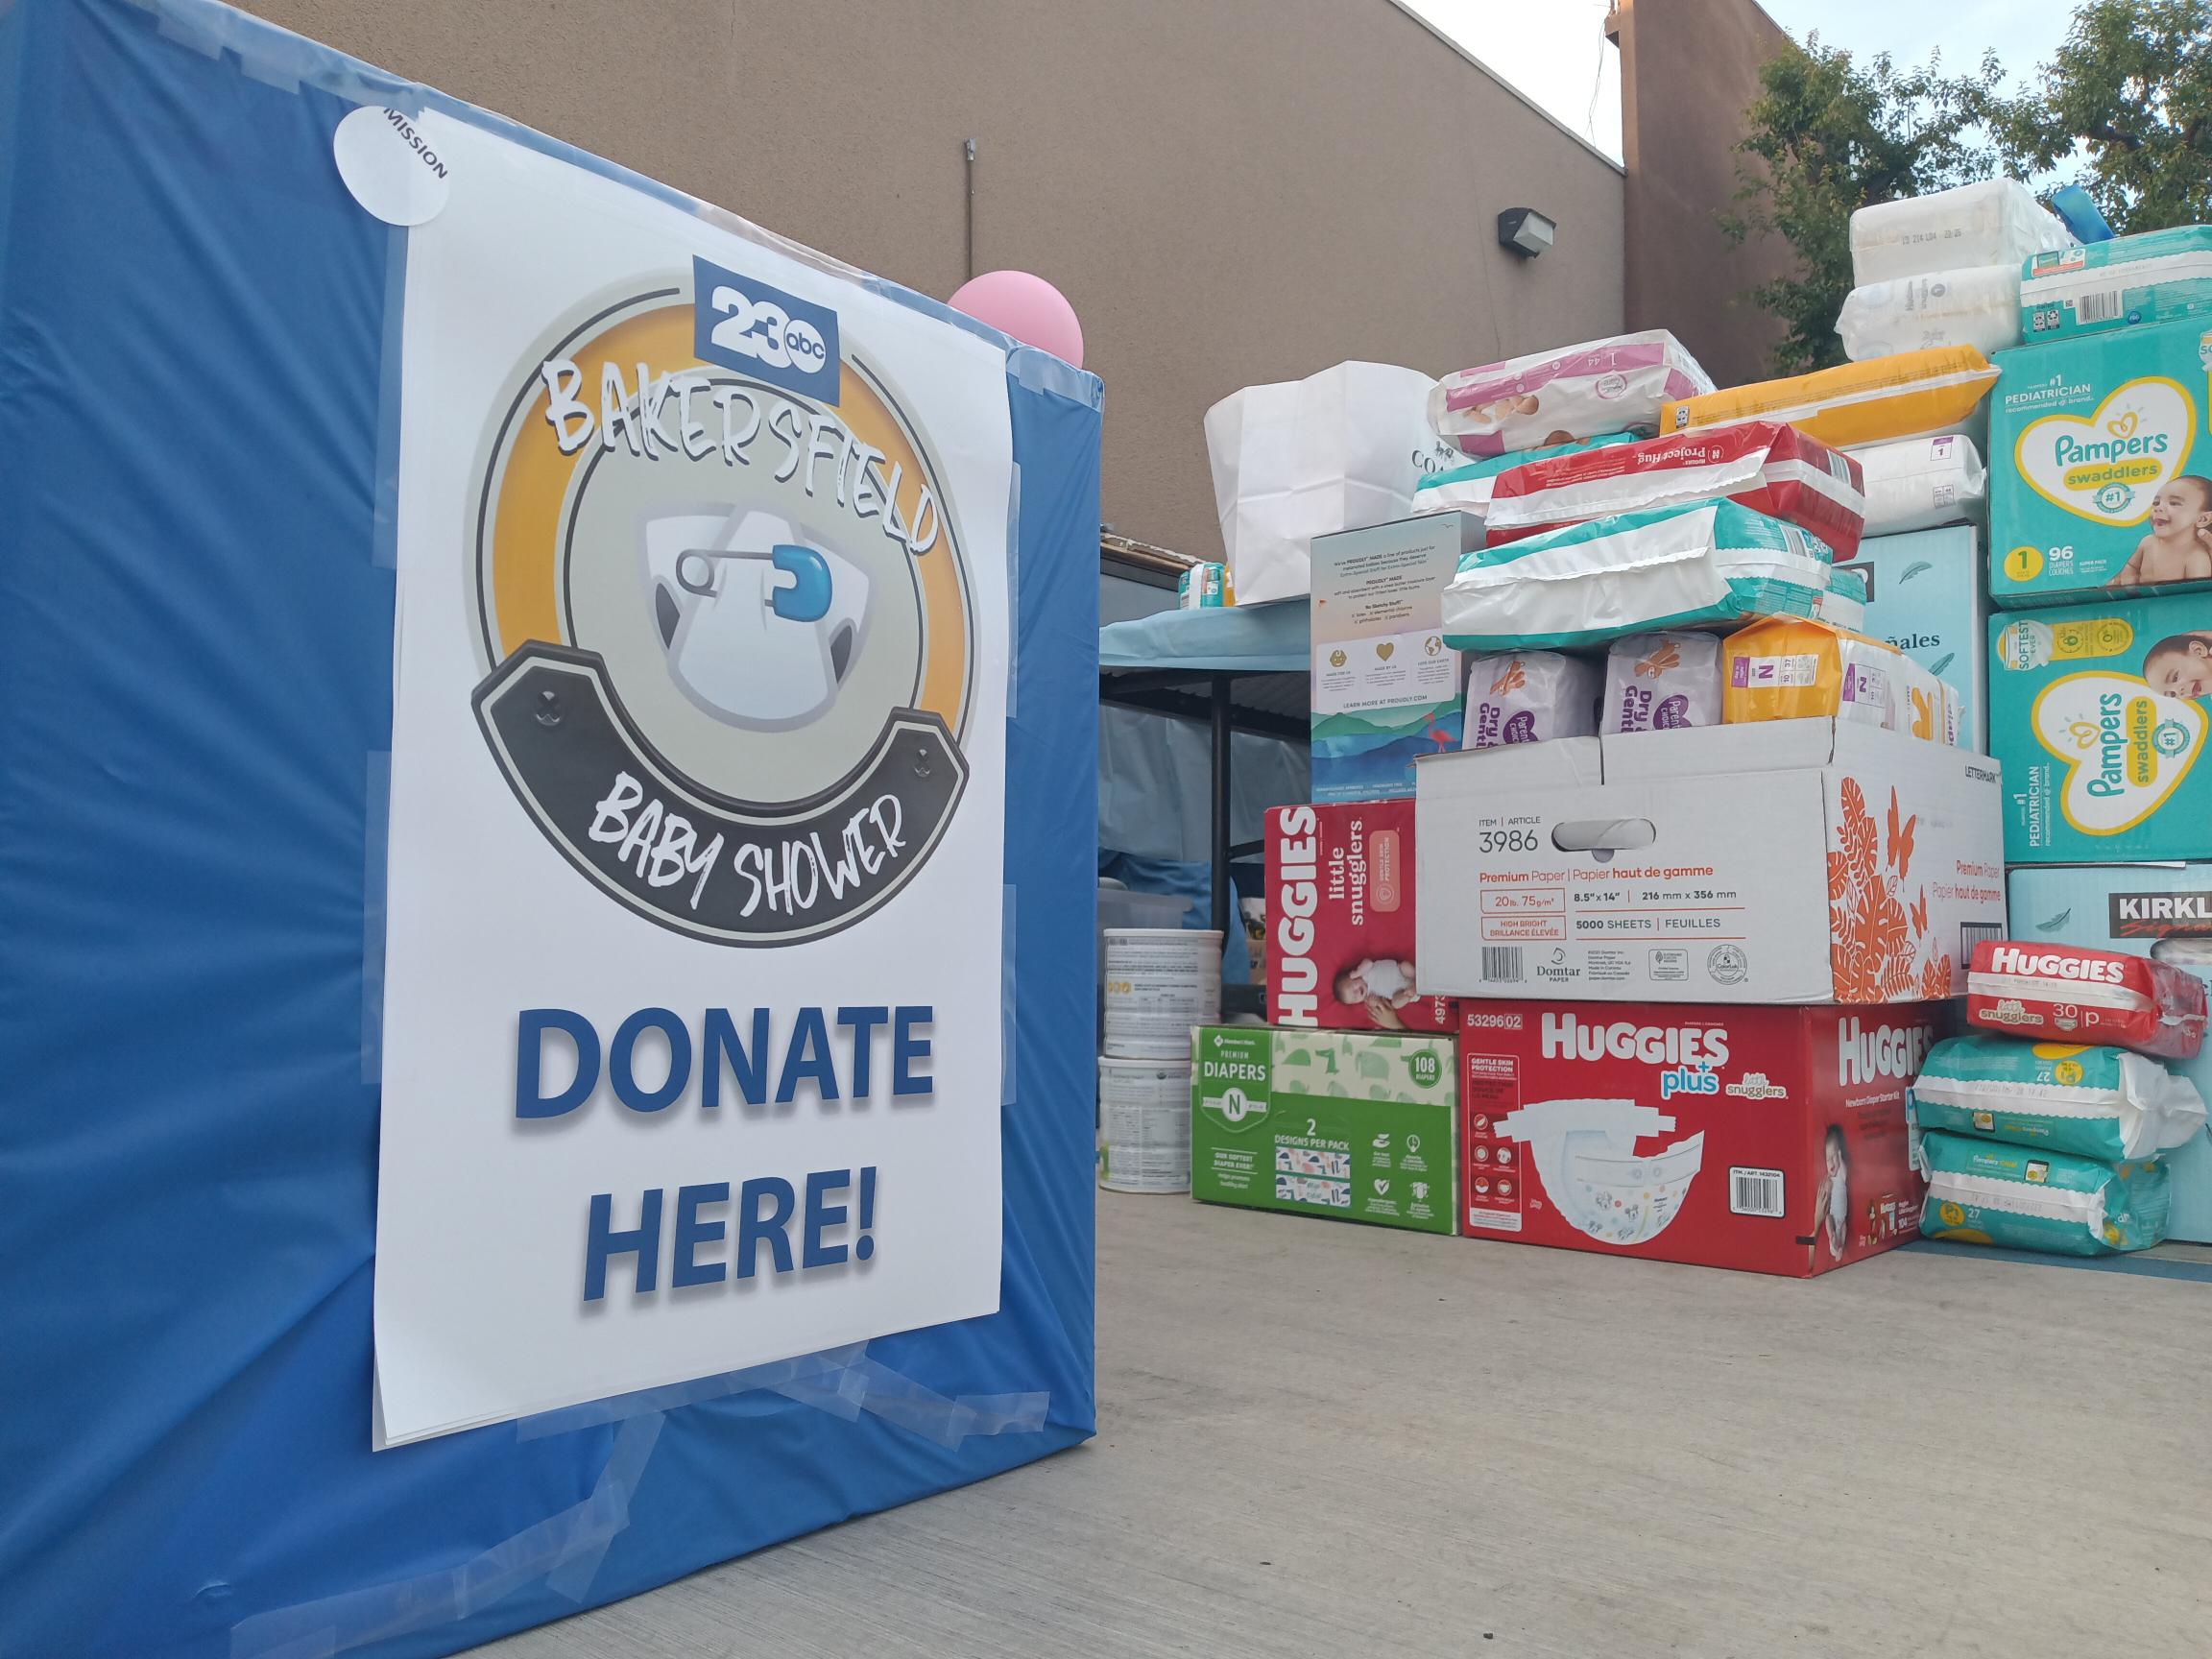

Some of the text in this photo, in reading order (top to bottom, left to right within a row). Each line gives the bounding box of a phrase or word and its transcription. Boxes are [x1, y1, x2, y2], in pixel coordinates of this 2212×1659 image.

[383, 108, 448, 179] MISSION
[711, 286, 825, 368] 23 abc
[2005, 384, 2091, 404] PEDIATRICIAN
[2005, 400, 2057, 413] recommended
[541, 359, 940, 554] BAKERSFIELD
[2056, 434, 2168, 467] Pampers
[2068, 465, 2158, 485] swaddlers
[2105, 492, 2121, 502] #1
[2018, 546, 2074, 569] 1 96
[2049, 560, 2074, 568] DIAPERS
[2049, 567, 2074, 576] COUCHES
[2019, 619, 2029, 670] SOFTEST
[1758, 664, 1774, 679] N
[1859, 676, 1867, 693] N
[1634, 690, 1652, 721] Dry
[1486, 707, 1500, 737] Dry
[2087, 693, 2128, 797] Pampers
[2133, 701, 2150, 782] swaddlers
[2163, 733, 2176, 746] #1
[2029, 766, 2040, 847] PEDIATRICIAN
[1507, 816, 1541, 825] ARTICLE
[589, 771, 907, 916] BABY SHOWER
[1479, 830, 1538, 854] 3986
[1329, 847, 1345, 900] little
[1347, 820, 1367, 926] snugglers
[1479, 866, 1714, 883] Premium Paper Papier haut de gamme
[1956, 860, 2000, 878] Premium Paper
[1642, 892, 1660, 901] 216
[1694, 890, 1714, 899] 356
[1933, 881, 2002, 904] Papier haut de gamme
[1278, 805, 1318, 1027] HUGGIES
[1575, 918, 1721, 929] 5000 SHEETS FEUILLES
[1490, 926, 1559, 937] BRILLANCE ÉLEVÉE
[1536, 966, 1581, 977] Domtar
[1990, 947, 2125, 984] HUGGIES
[1980, 1010, 2043, 1024] snugglers
[2053, 1003, 2078, 1019] 30
[1541, 1012, 1729, 1067] HUGGIES
[516, 1005, 933, 1118] DONATE
[1220, 1050, 1249, 1060] PREMIUM
[1415, 1056, 1435, 1073] 108
[1204, 1061, 1266, 1082] DIAPERS
[2036, 1070, 2051, 1082] 27
[1662, 1068, 1717, 1097] plus
[1727, 1086, 1785, 1098] snugglers
[1229, 1094, 1240, 1115] N
[1306, 1118, 1316, 1136] 2
[1274, 1134, 1350, 1151] DESIGNS PER PACK
[1968, 1208, 1981, 1219] 27
[583, 1166, 878, 1301] HERE!
